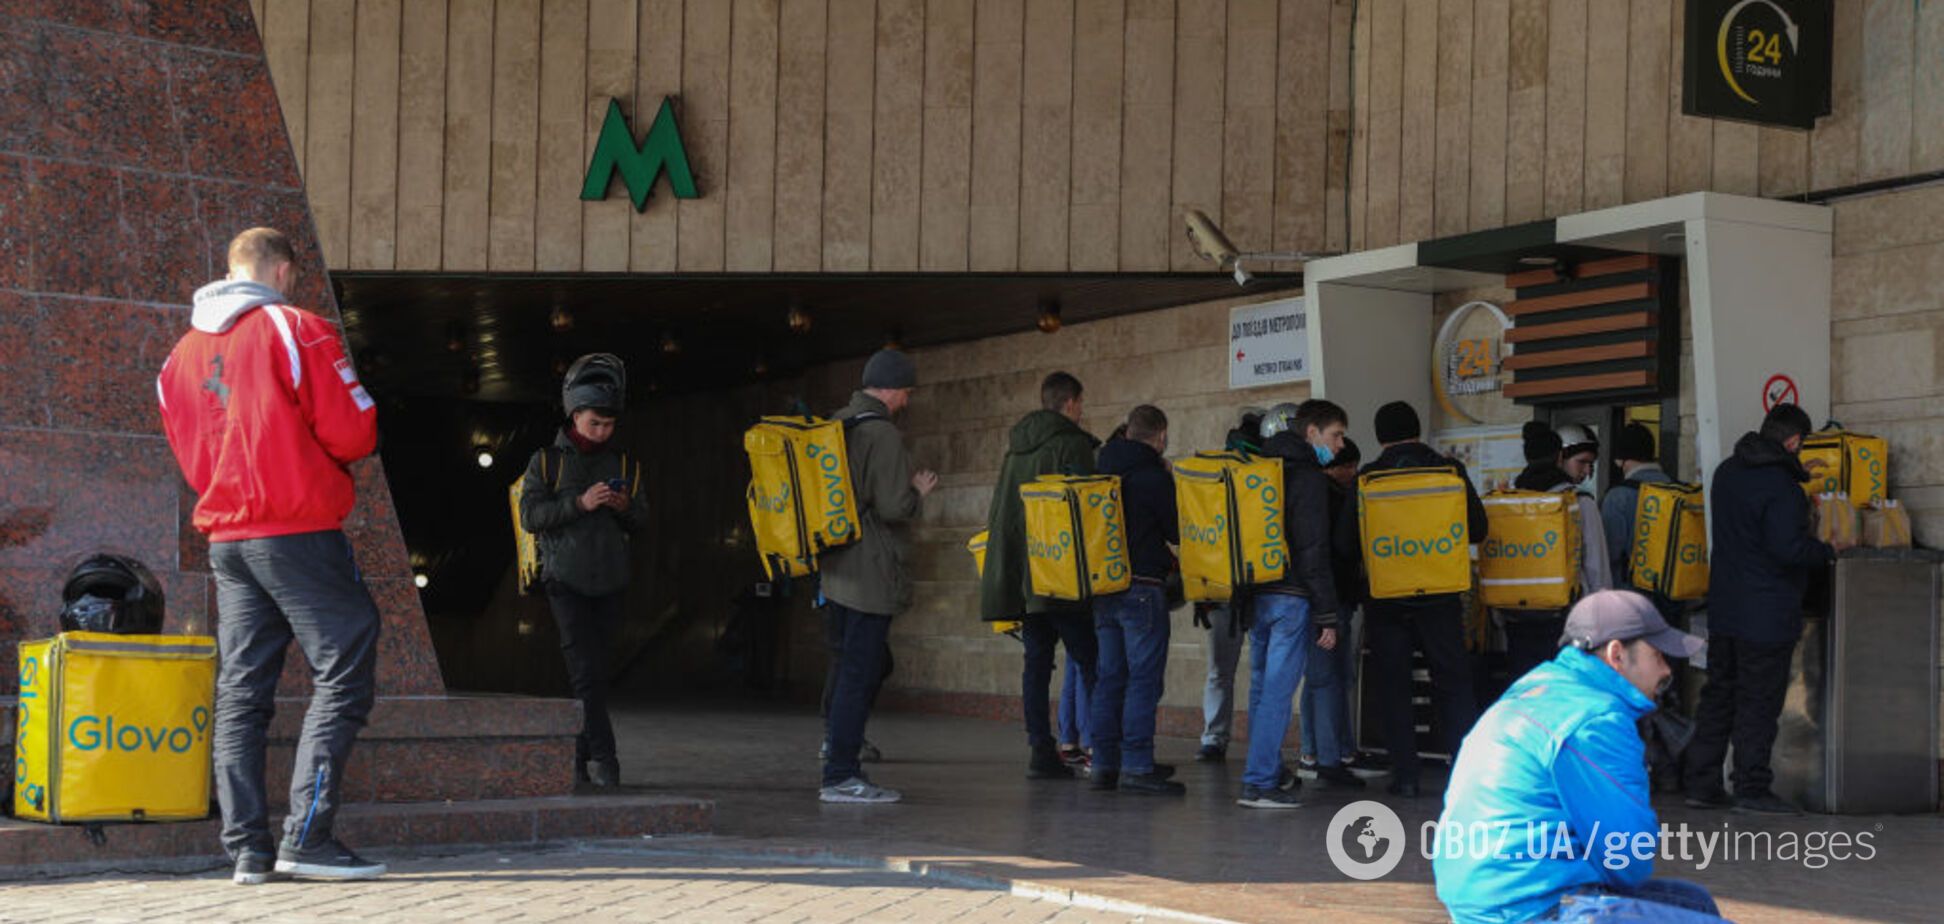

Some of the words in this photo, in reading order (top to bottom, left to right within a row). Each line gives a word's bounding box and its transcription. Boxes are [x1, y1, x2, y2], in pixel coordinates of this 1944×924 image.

[1748, 29, 1782, 65] 24
[1254, 361, 1278, 375] METRO
[1279, 358, 1303, 374] TRAINS
[1456, 337, 1493, 377] 24
[820, 453, 849, 538] Glovo
[1102, 503, 1124, 581] Glovo
[1261, 485, 1284, 571] Glovo
[1372, 535, 1453, 558] Glovo
[1634, 495, 1660, 567] Glovo
[1485, 539, 1547, 559] Glovo
[16, 656, 38, 784] Glovo
[68, 715, 193, 753] Glovo
